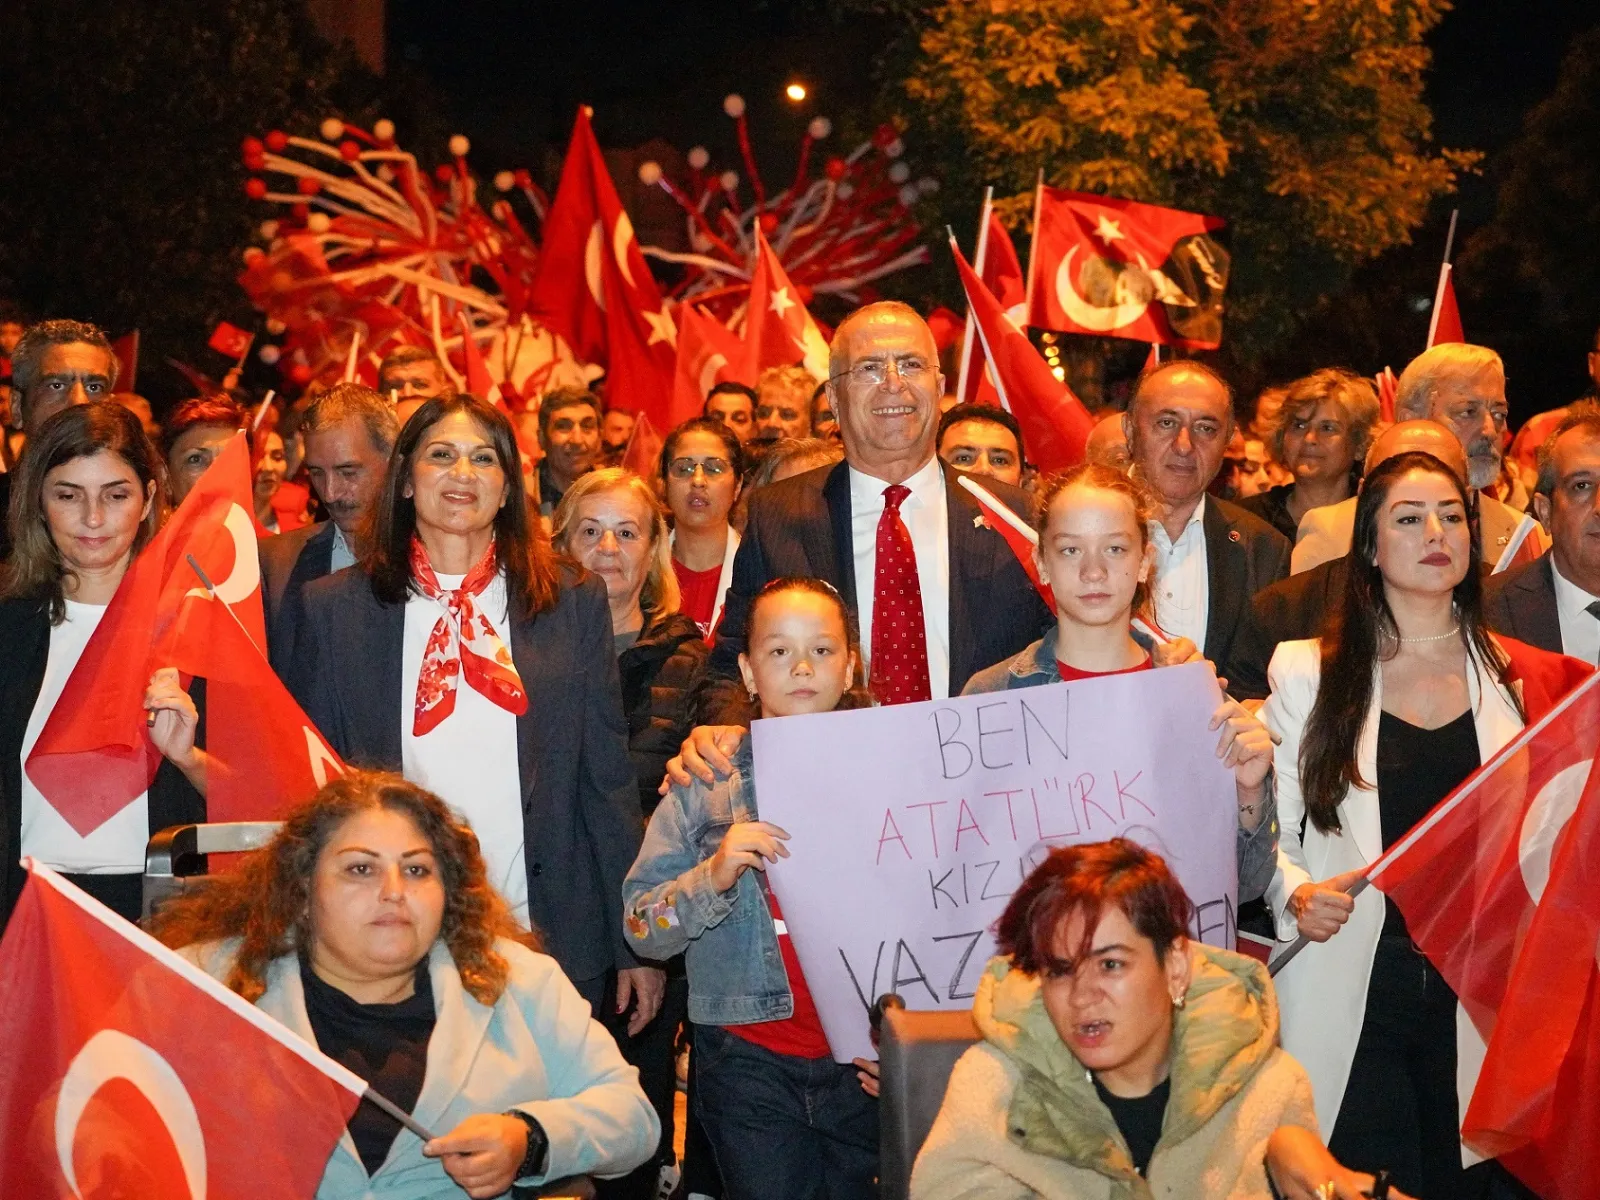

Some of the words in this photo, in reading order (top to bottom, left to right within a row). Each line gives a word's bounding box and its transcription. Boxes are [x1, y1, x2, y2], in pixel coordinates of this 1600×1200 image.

[928, 689, 1070, 779] BEN
[876, 769, 1156, 866] ATATÜRK
[837, 929, 984, 1012] VAZ
